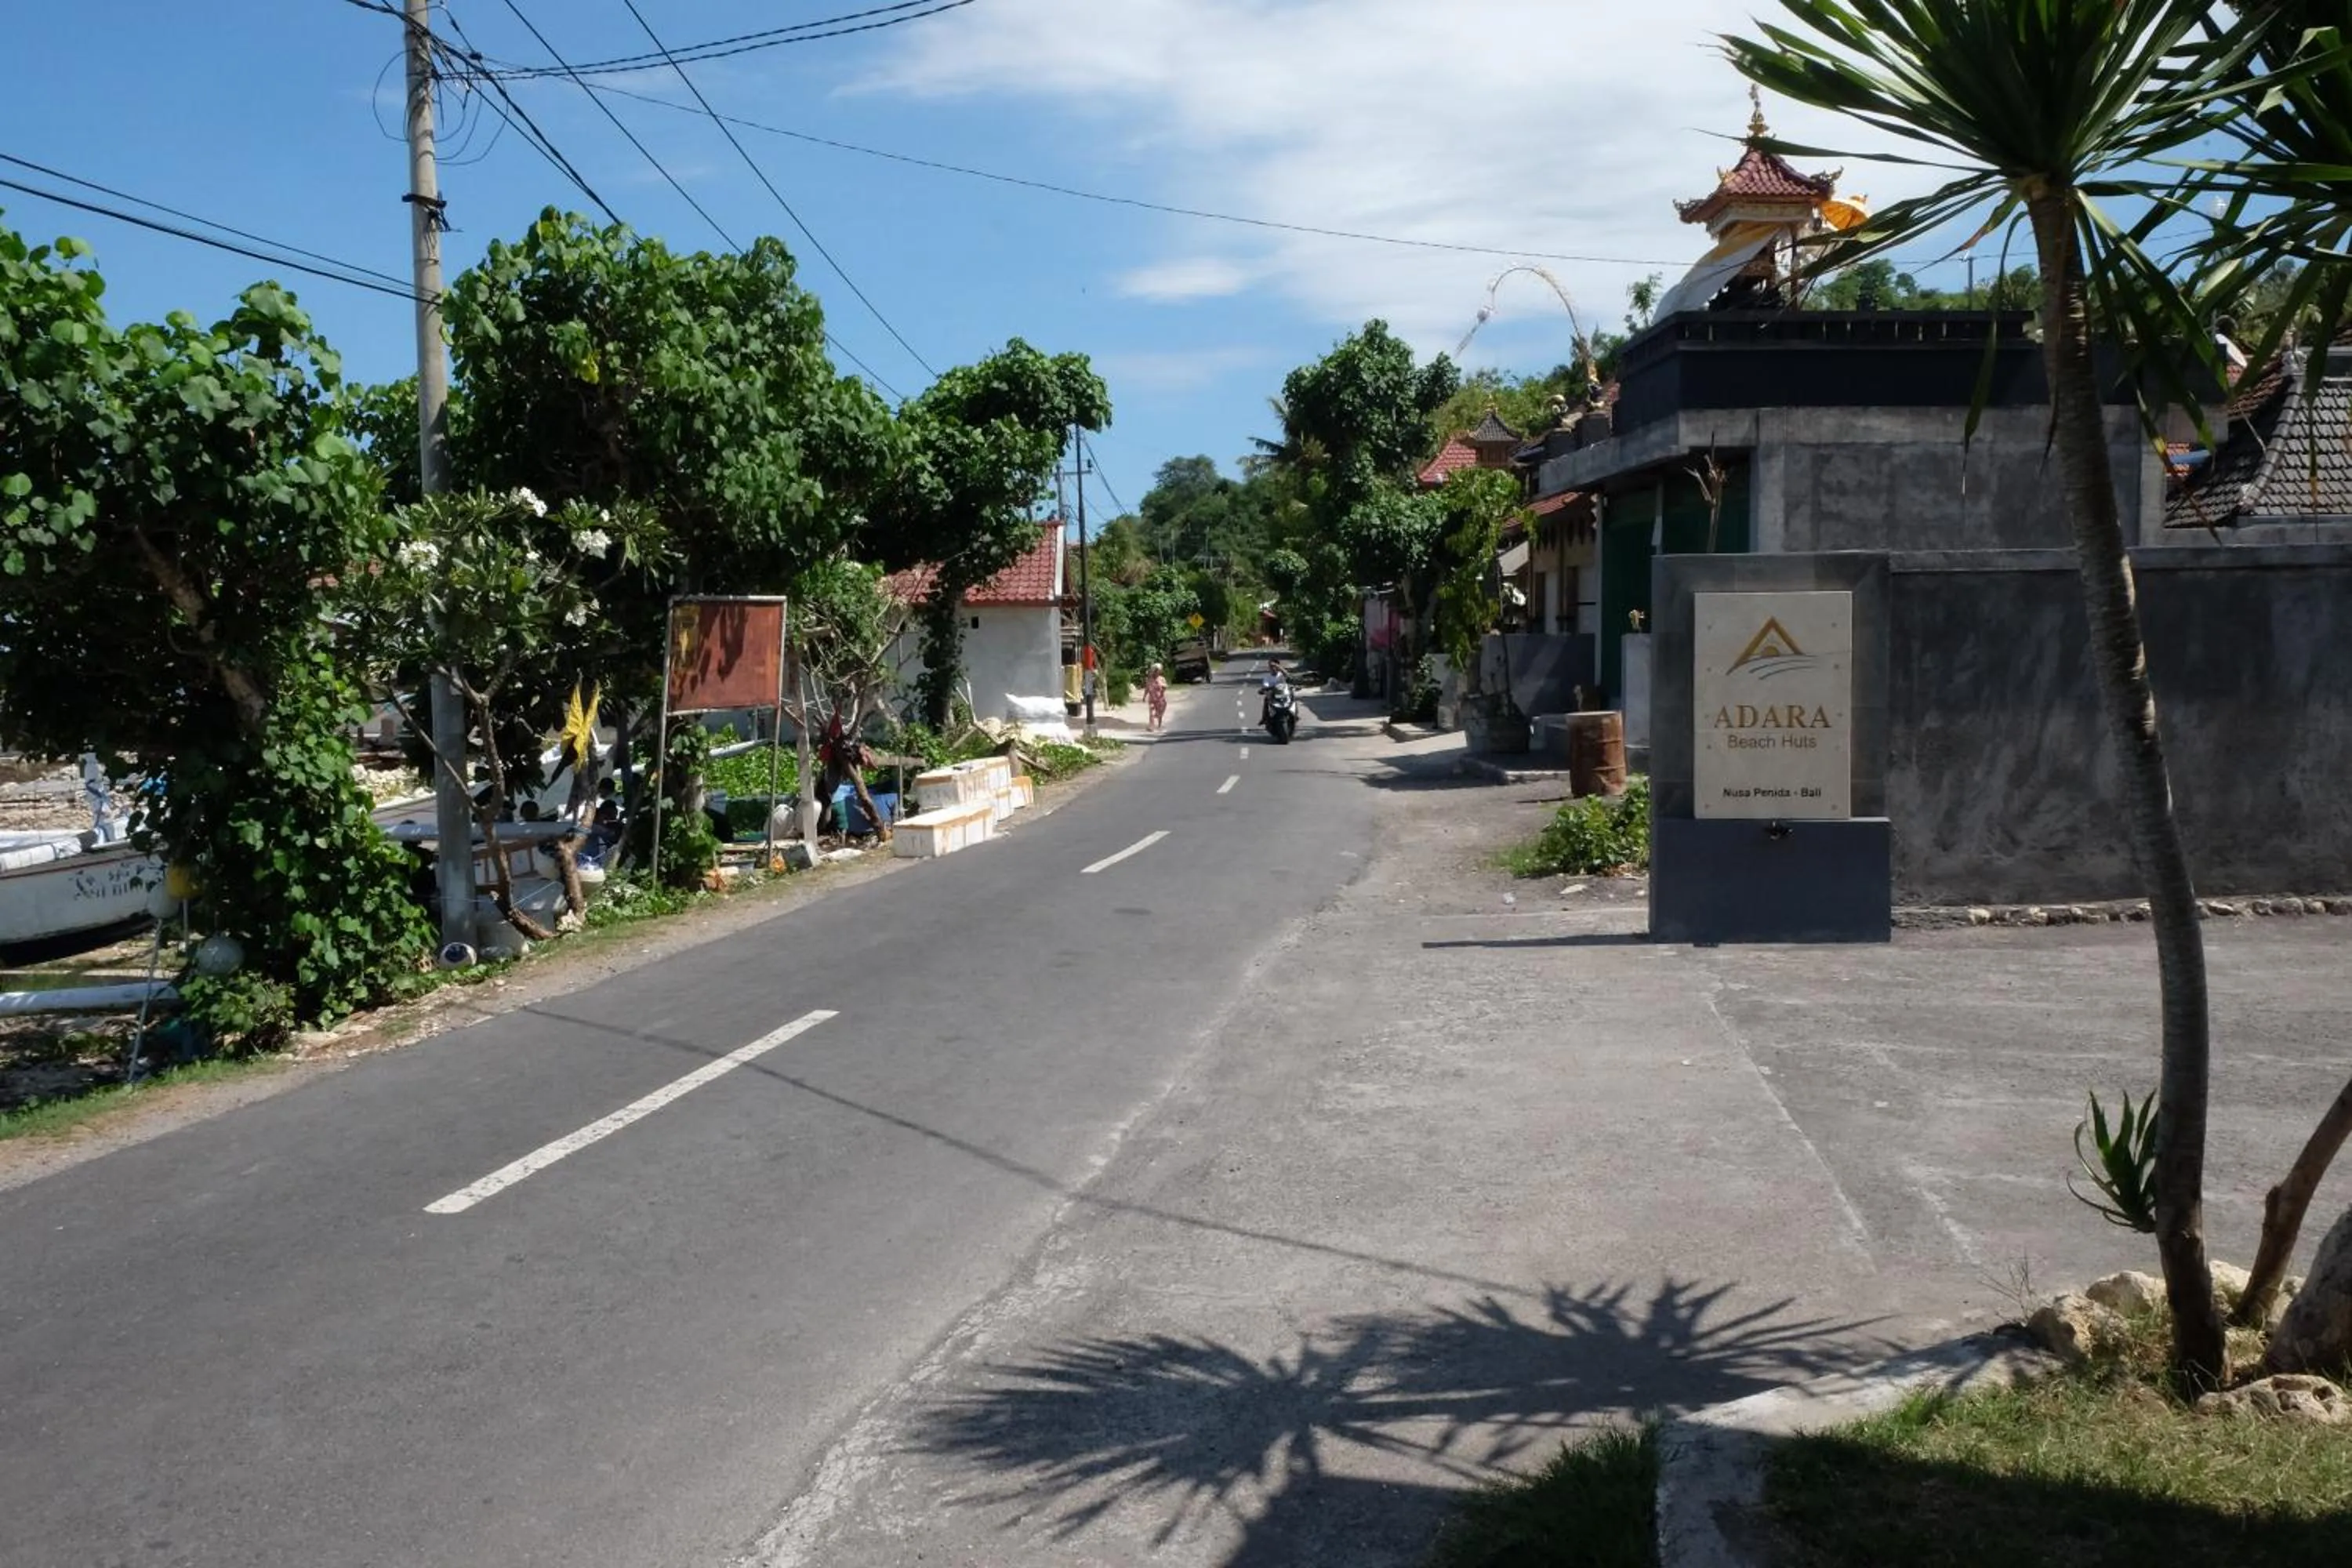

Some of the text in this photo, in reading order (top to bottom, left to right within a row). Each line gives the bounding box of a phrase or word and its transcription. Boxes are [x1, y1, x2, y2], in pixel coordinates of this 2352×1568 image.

[1714, 705, 1831, 728] ADARA
[1727, 735, 1817, 749] Beach Huts
[1722, 787, 1751, 797] Nusa
[1754, 787, 1791, 797] Penida
[1800, 787, 1822, 797] Bali
